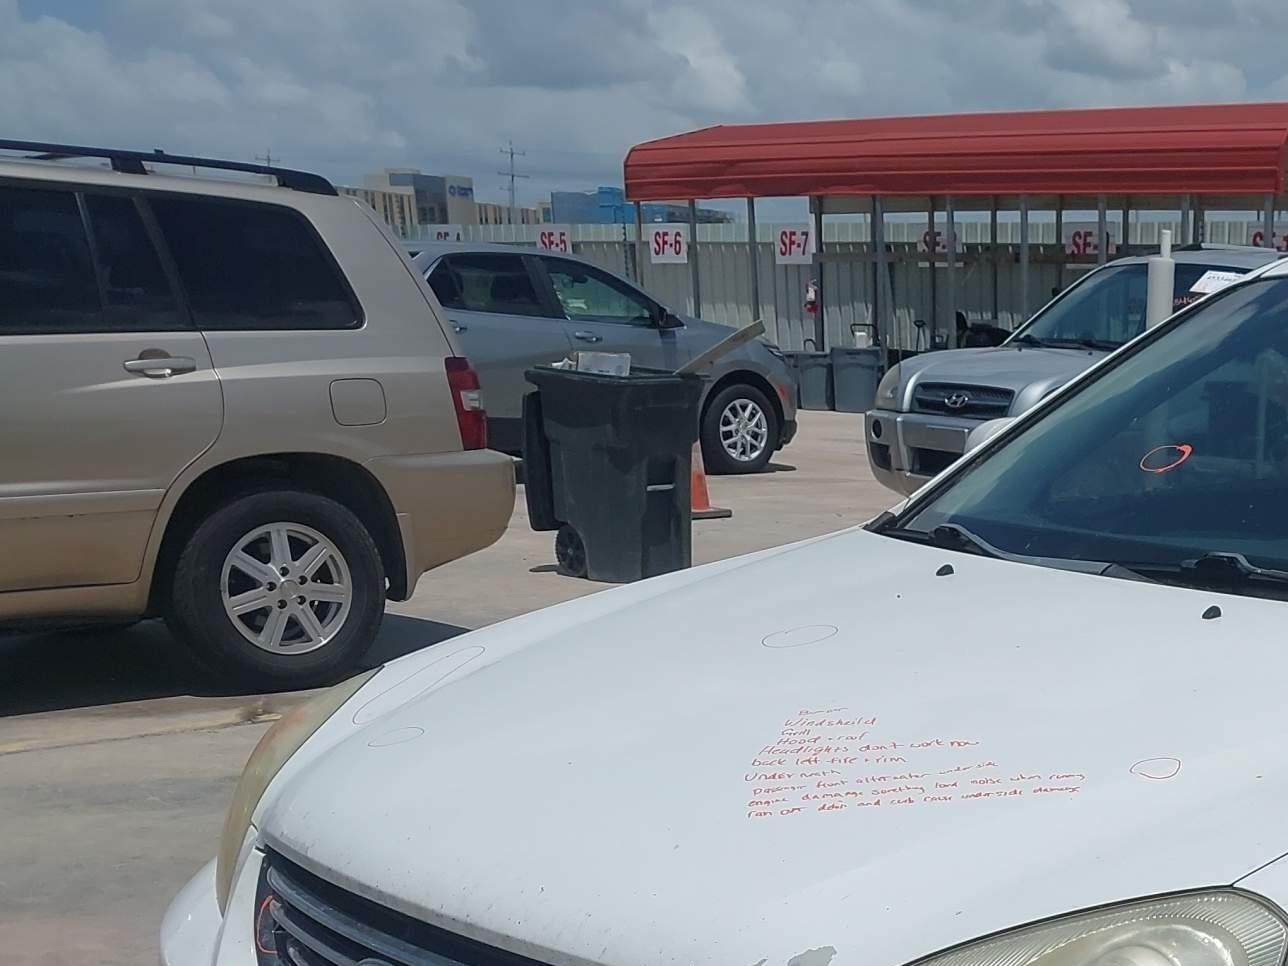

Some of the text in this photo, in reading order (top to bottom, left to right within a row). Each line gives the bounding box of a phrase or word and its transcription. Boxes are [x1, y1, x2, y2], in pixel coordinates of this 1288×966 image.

[540, 231, 567, 252] SF-5
[654, 231, 682, 256] SF-6
[780, 231, 809, 256] SF-7
[777, 736, 822, 746] Hood
[759, 745, 849, 757] Headlights
[748, 810, 773, 819] ran
